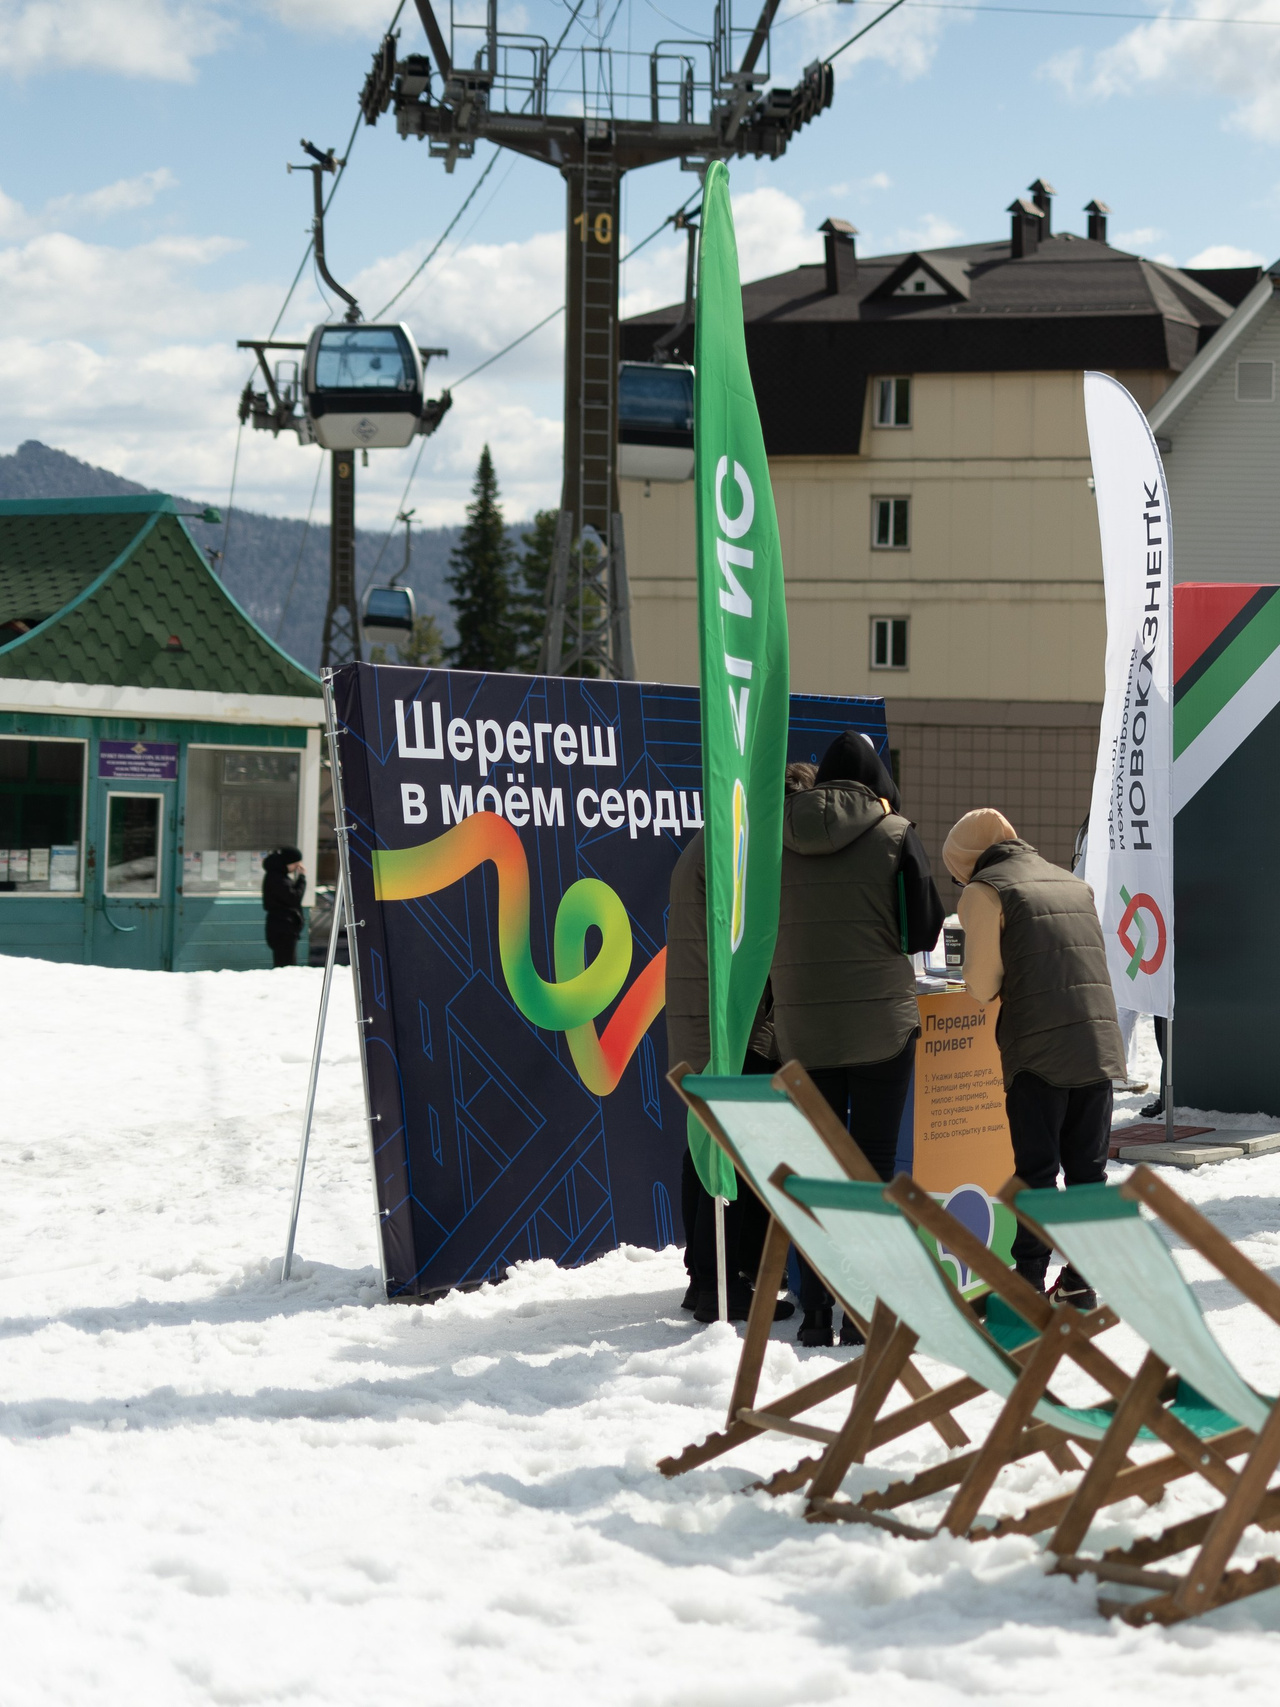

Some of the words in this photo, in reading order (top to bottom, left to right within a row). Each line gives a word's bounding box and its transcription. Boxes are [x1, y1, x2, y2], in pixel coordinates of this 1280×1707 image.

[573, 211, 613, 244] 10
[394, 699, 617, 777] Шерегеш
[400, 783, 428, 825] в
[440, 773, 565, 827] моём
[576, 787, 705, 840] сердц
[926, 1009, 986, 1034] Передай
[925, 1036, 974, 1056] привет
[931, 1073, 952, 1082] Укажи
[954, 1070, 972, 1081] адрес
[974, 1068, 994, 1078] друга.
[924, 1086, 930, 1094] 2.
[931, 1083, 957, 1094] Напиши
[959, 1082, 971, 1090] ему
[972, 1077, 1004, 1088] что-нибуд
[931, 1096, 954, 1105] милое:
[955, 1092, 988, 1103] например,
[943, 1104, 974, 1116] скучаешь
[981, 1099, 1002, 1109] ждёшь
[948, 1117, 968, 1126] гости.
[924, 1133, 929, 1141] 3.
[931, 1130, 950, 1140] Брось
[951, 1126, 981, 1137] открытку
[987, 1123, 1005, 1132] ящик.
